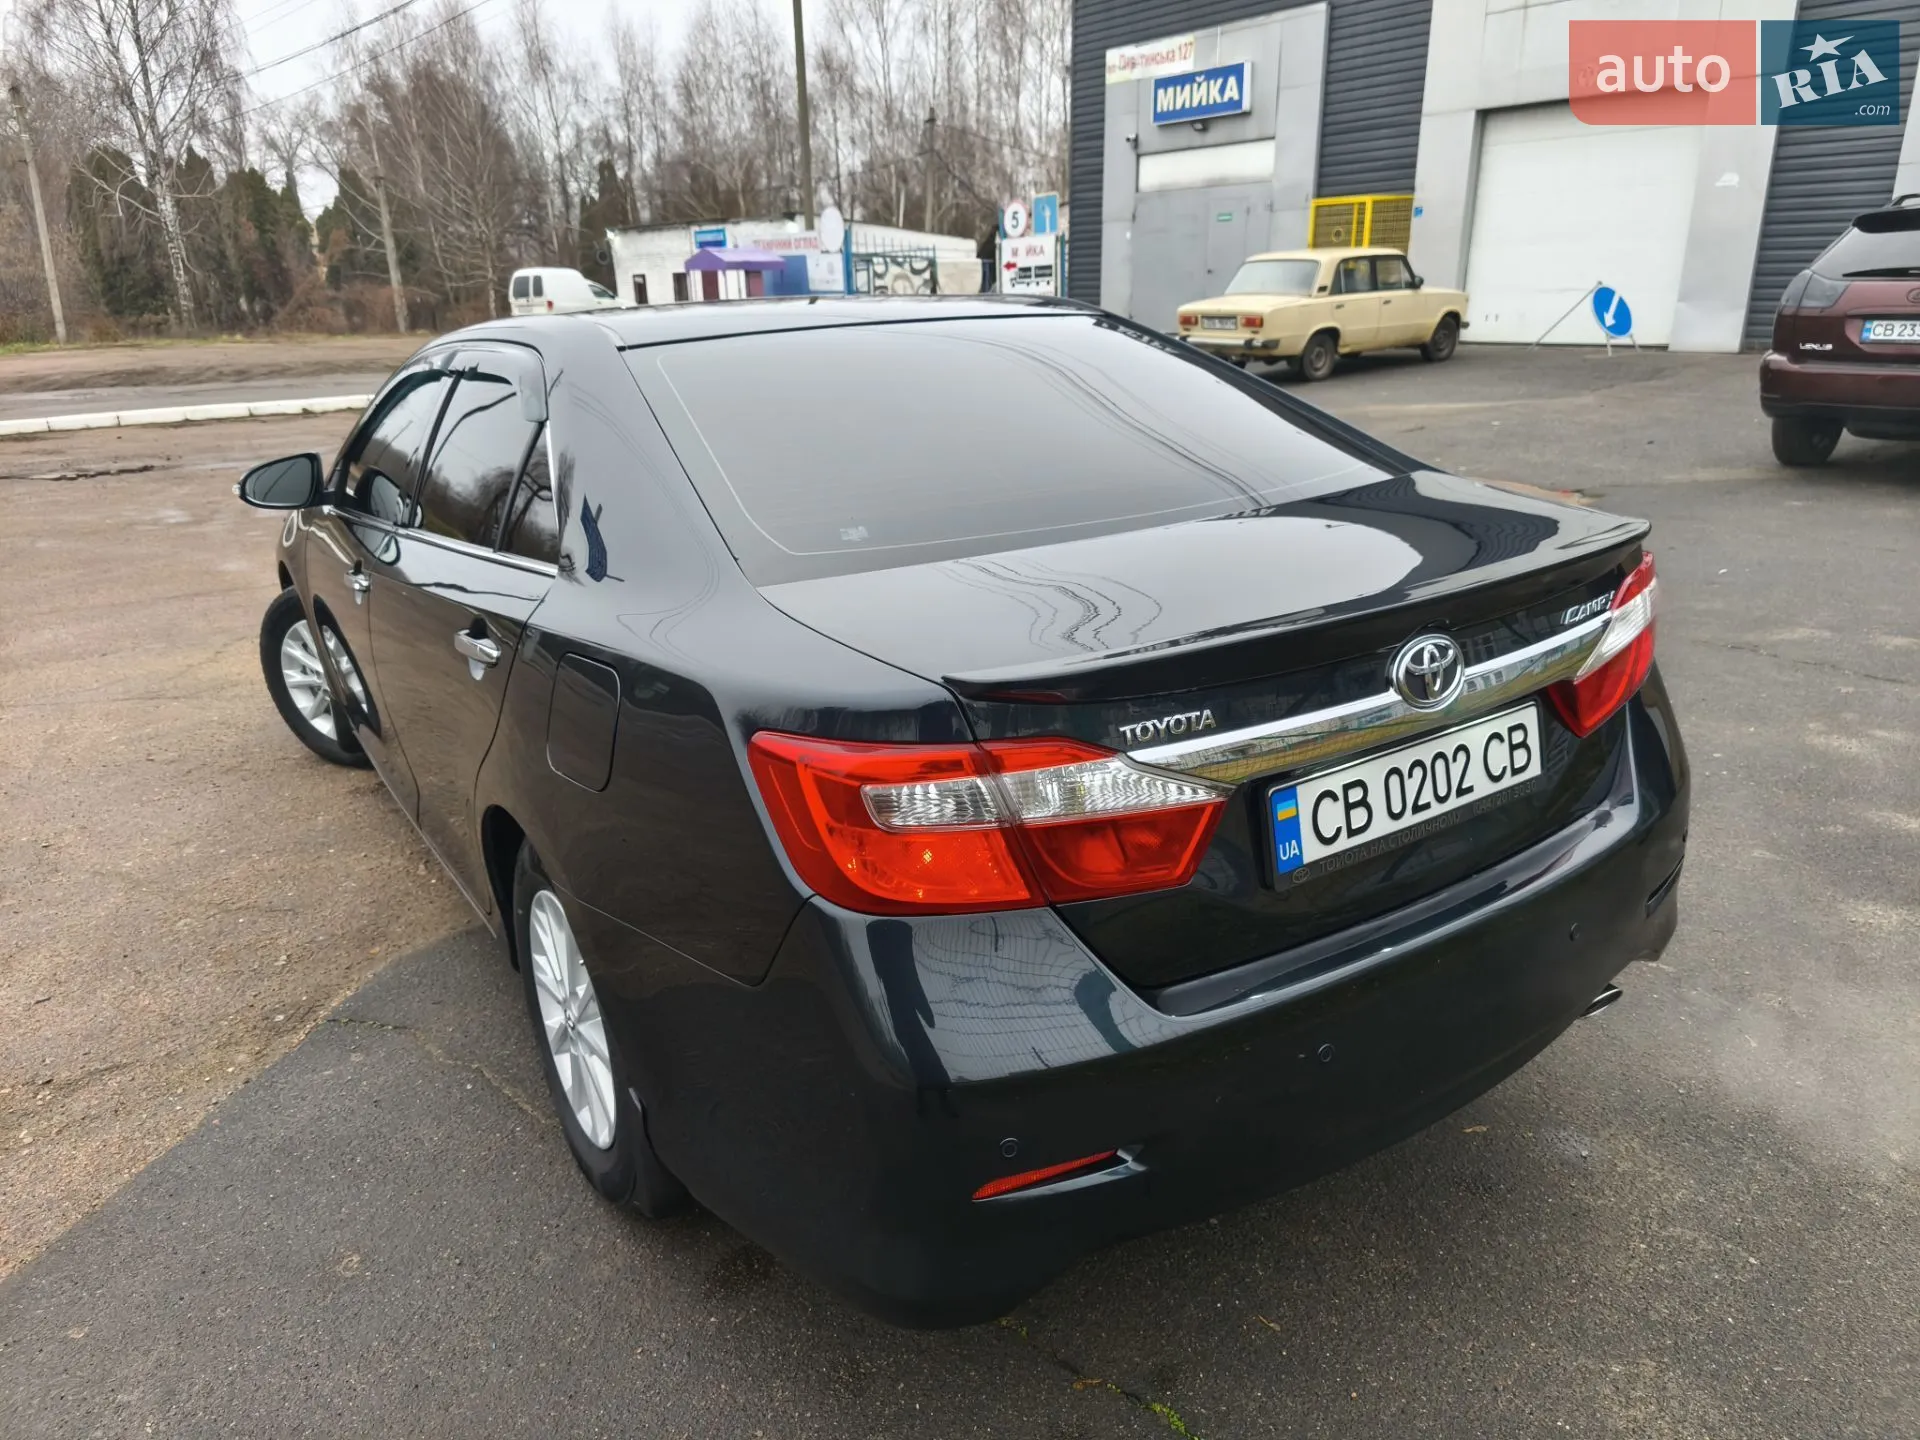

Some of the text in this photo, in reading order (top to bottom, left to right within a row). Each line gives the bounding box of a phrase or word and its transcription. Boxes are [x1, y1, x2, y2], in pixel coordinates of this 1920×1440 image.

[1156, 75, 1240, 114] МИЙКА
[1012, 210, 1020, 230] 5
[1872, 323, 1896, 337] CB
[1119, 709, 1217, 746] TOYOTA
[1312, 722, 1532, 846] CB 0202 CB
[1279, 840, 1300, 861] UA
